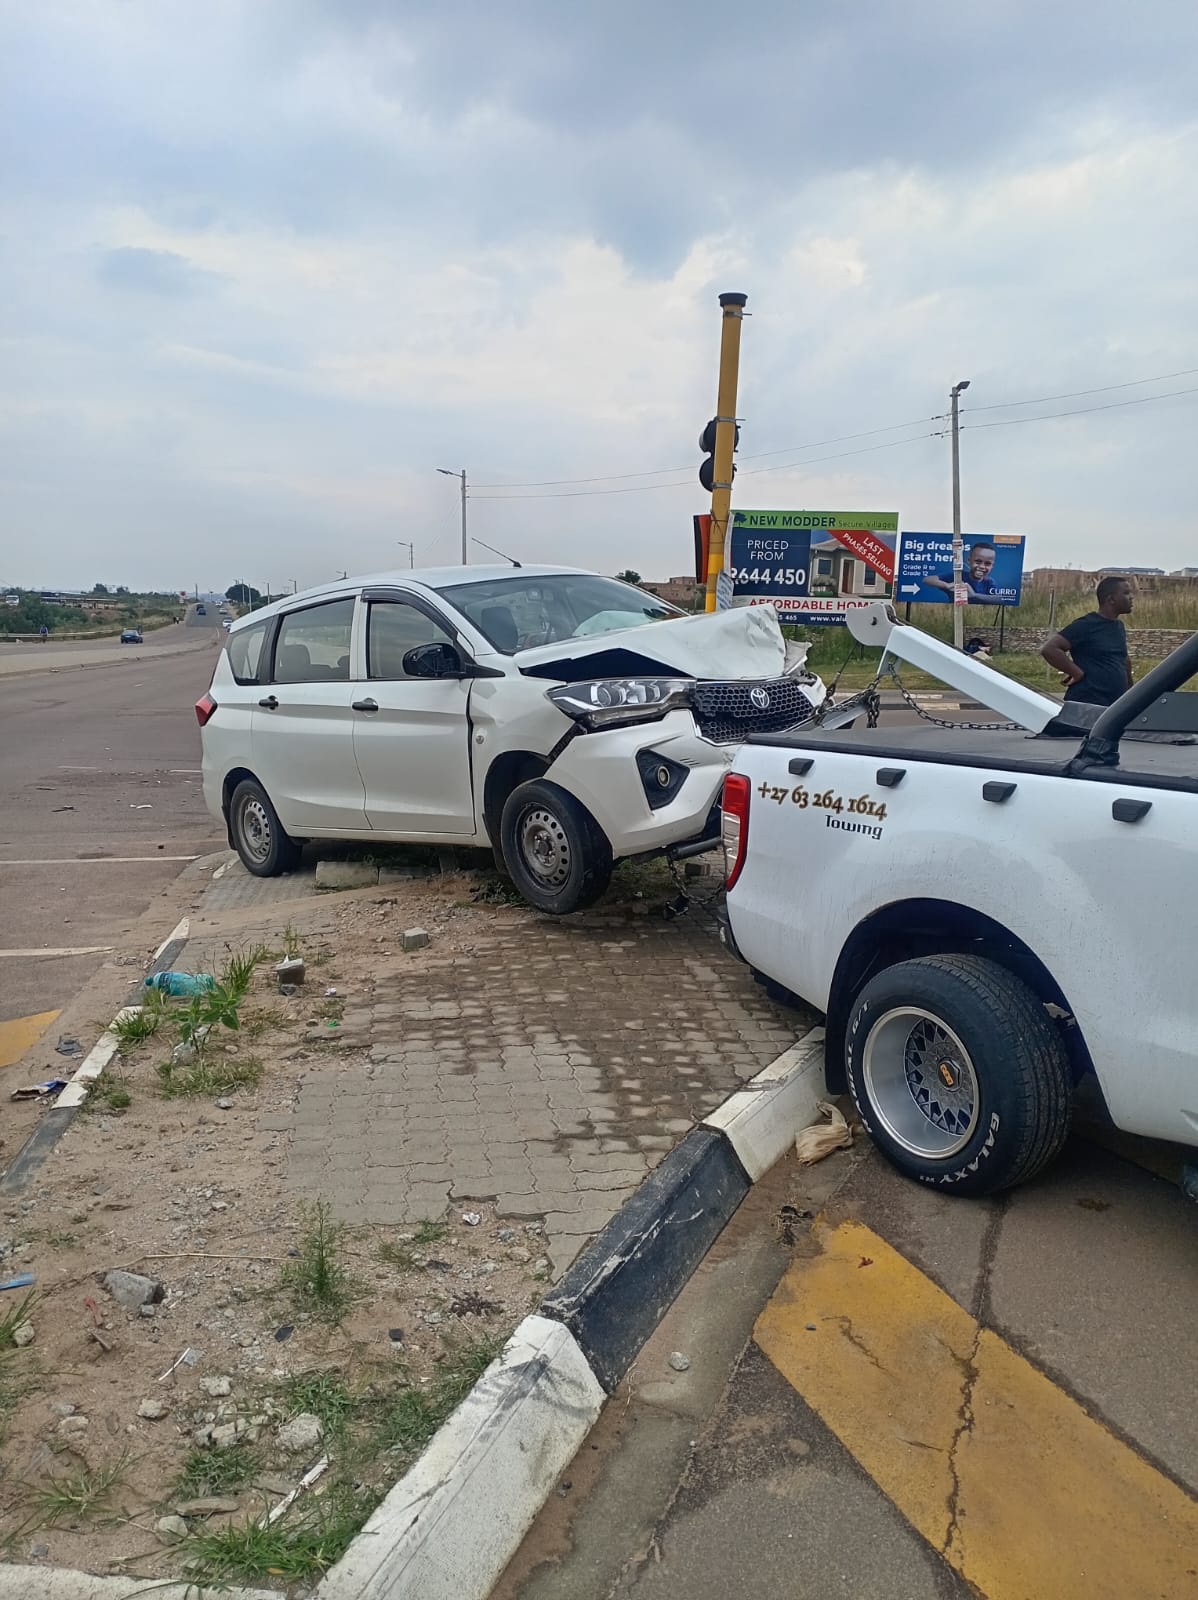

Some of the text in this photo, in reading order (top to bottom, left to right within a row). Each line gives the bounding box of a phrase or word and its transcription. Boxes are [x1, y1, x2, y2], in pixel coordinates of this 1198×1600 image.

[750, 515, 896, 529] NEW MODDER Secure Villages
[747, 540, 789, 550] PRICED
[863, 537, 884, 555] LAST
[904, 540, 971, 552] Big dreas
[750, 551, 784, 561] FROM
[843, 533, 893, 576] PHASES SELLING
[903, 552, 955, 562] start her
[774, 568, 806, 585] 450
[989, 587, 1017, 595] CURRO
[757, 782, 887, 821] +27 63 264 1614
[825, 814, 883, 840] Towing
[940, 1112, 1000, 1184] GALAXY
